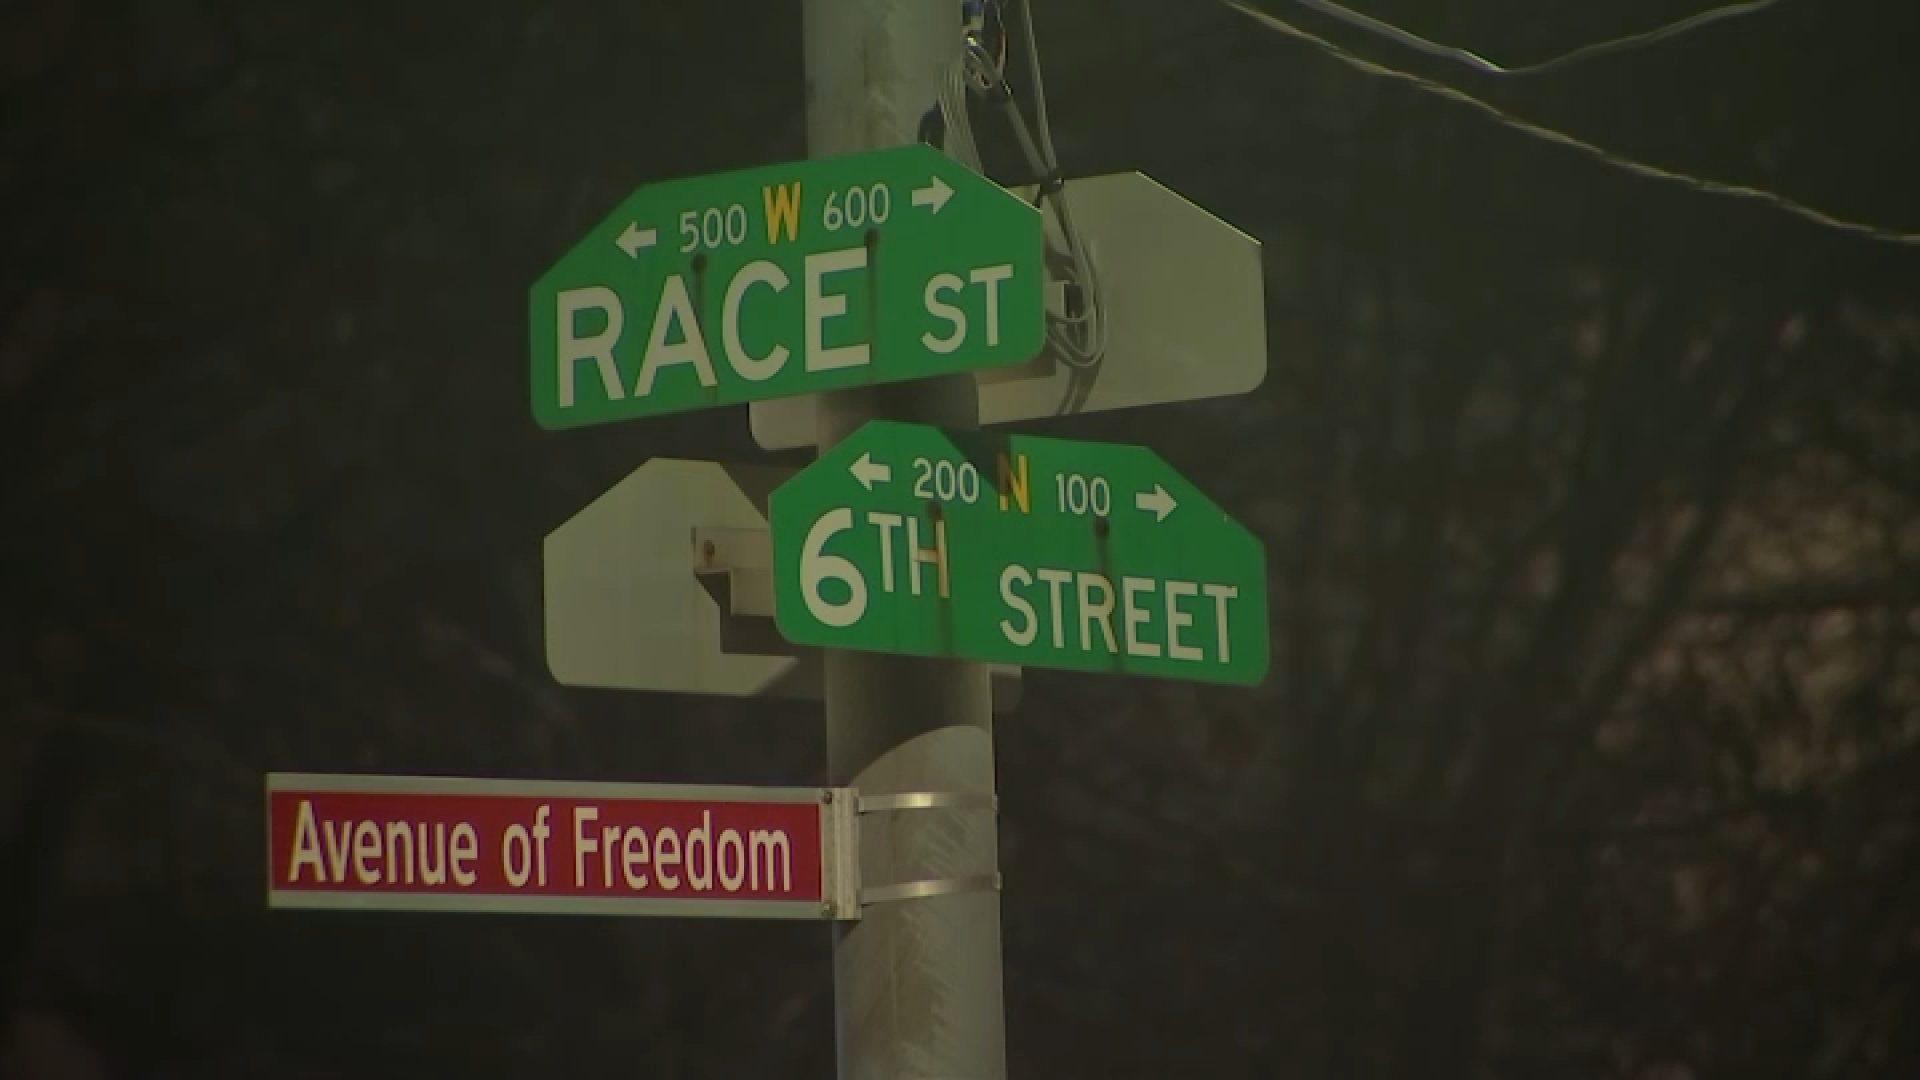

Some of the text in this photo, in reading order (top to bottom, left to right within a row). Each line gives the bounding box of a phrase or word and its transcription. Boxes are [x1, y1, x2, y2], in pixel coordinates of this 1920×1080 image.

[679, 182, 890, 253] 500 W 600
[557, 247, 1013, 408] RACE ST
[913, 451, 1110, 517] 200 N 100
[800, 508, 1238, 663] 6TH STREET
[288, 800, 792, 891] Avenue of Freedom
